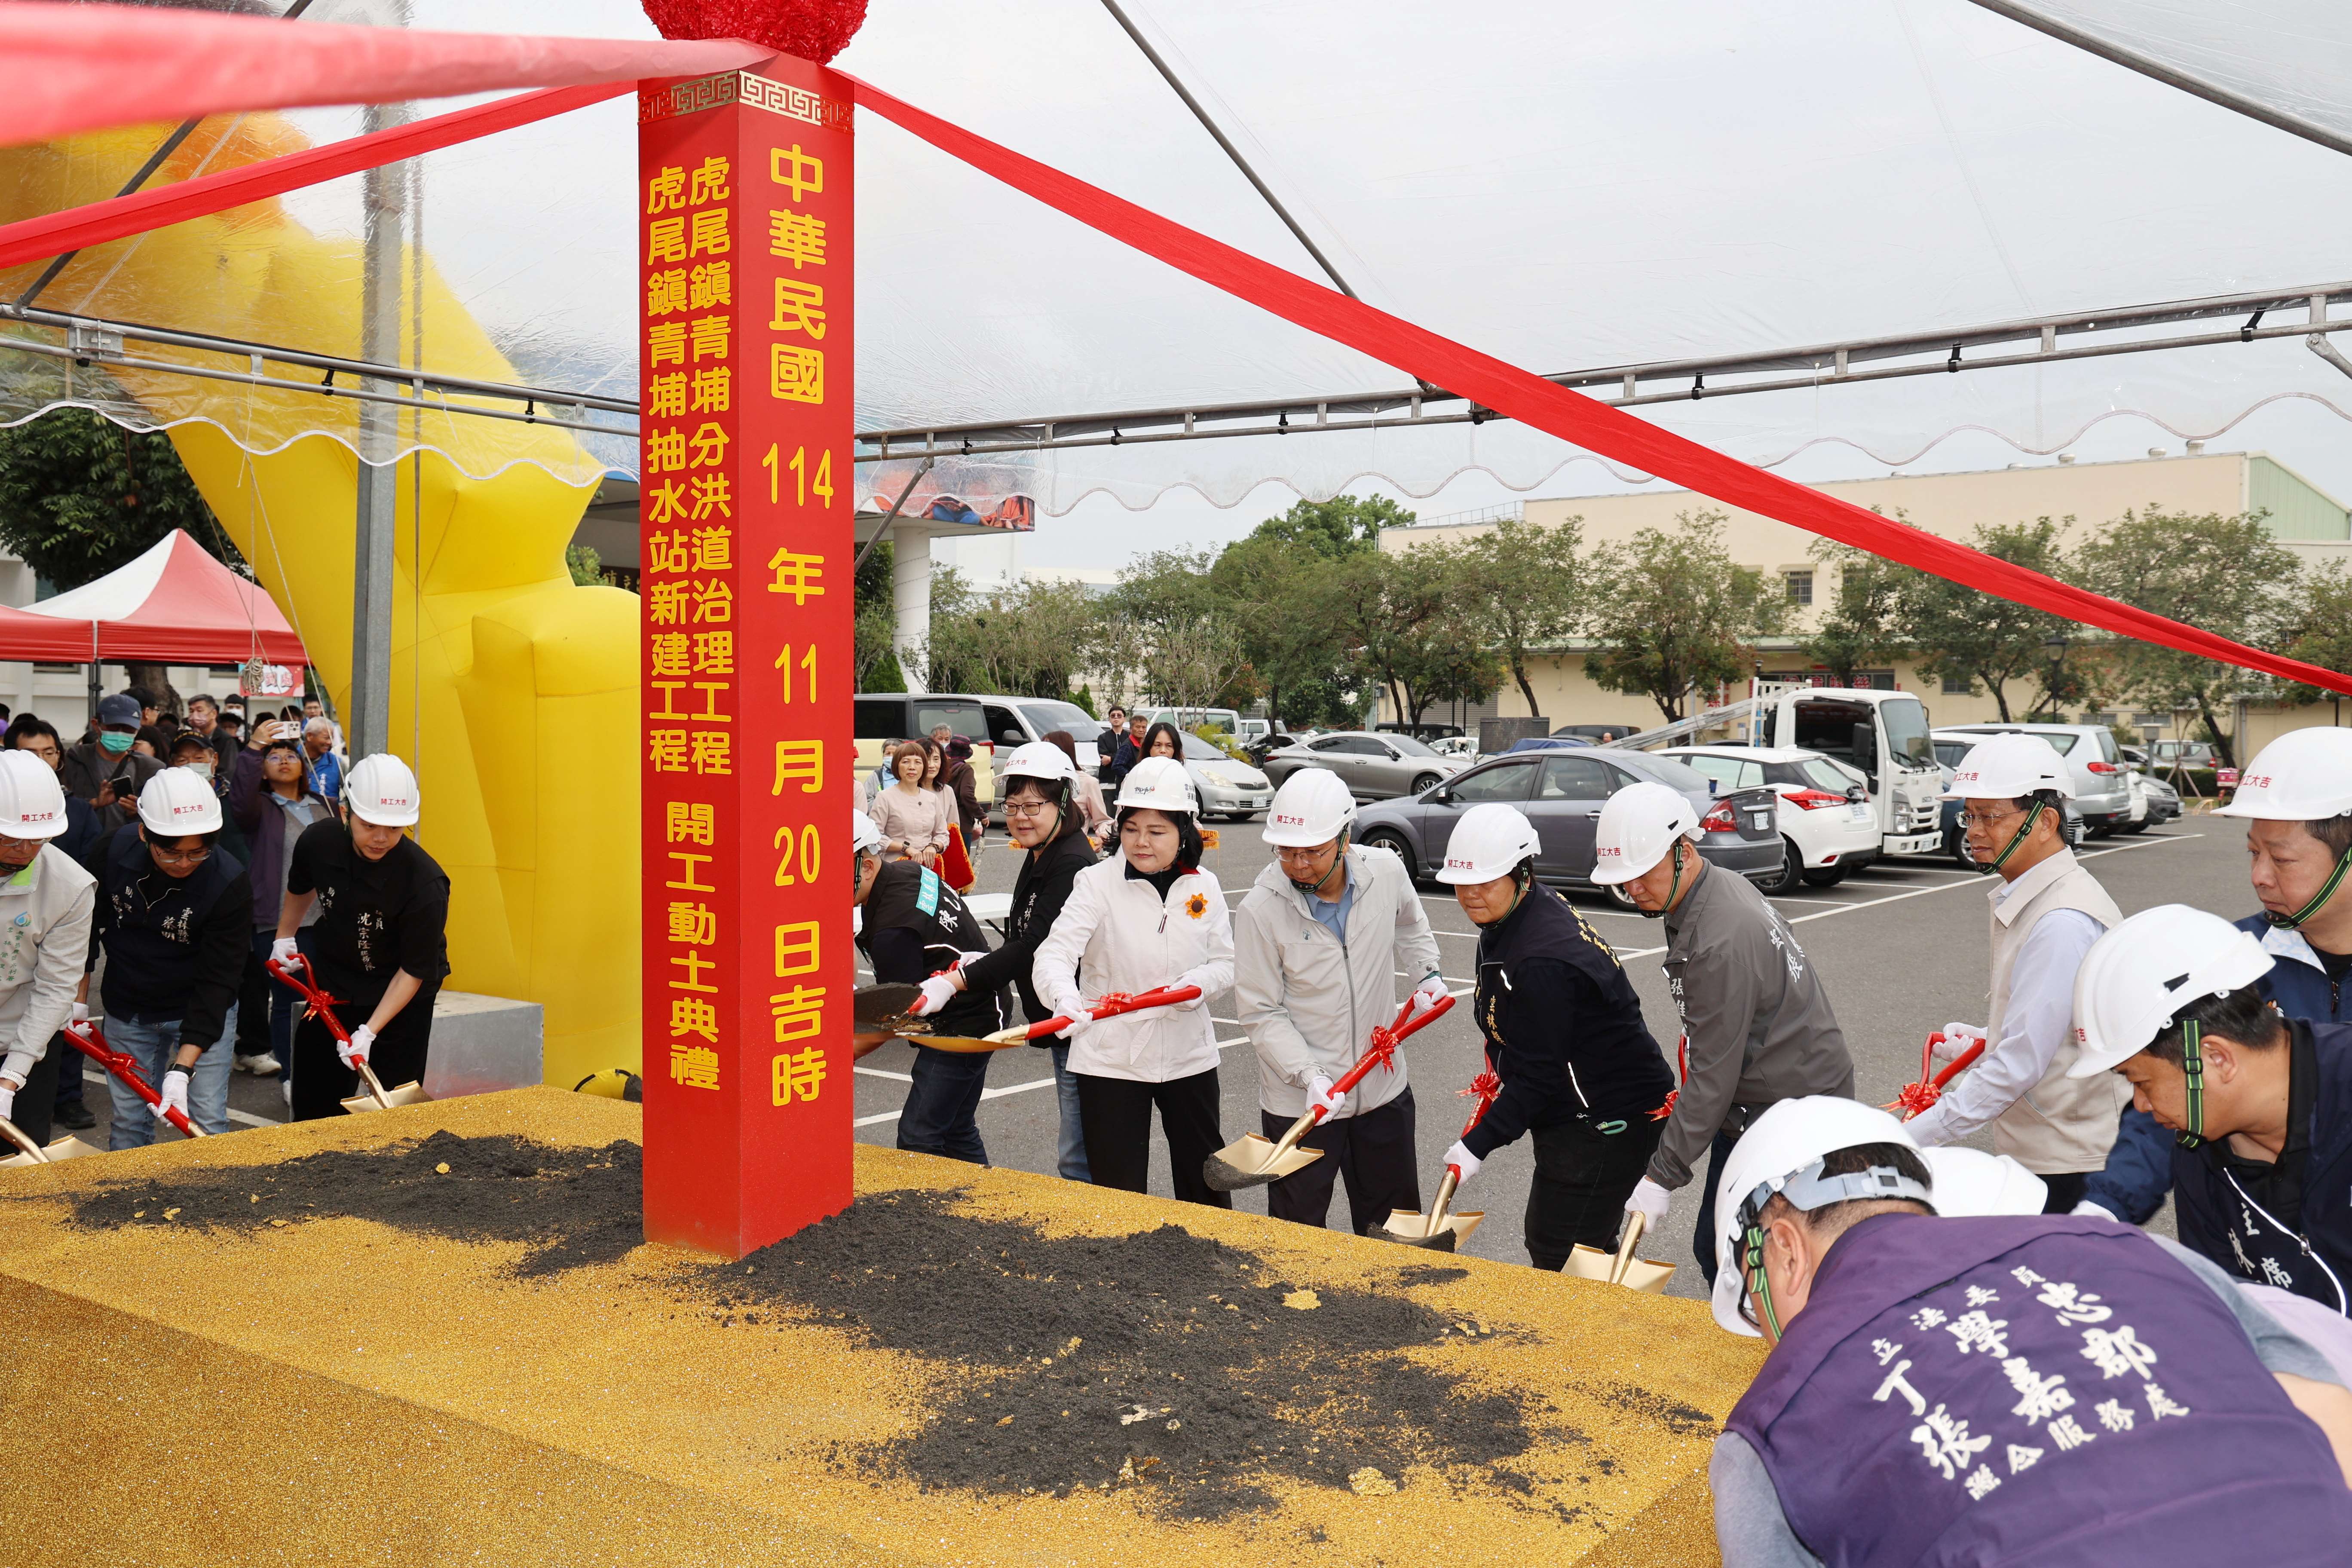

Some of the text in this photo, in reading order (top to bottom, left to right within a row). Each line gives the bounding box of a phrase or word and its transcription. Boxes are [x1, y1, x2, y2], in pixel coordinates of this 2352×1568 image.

[648, 167, 690, 772] 虎尾鎮青埔抽水站新建工程
[690, 157, 733, 775] 虎尾鎮青埔分洪道治理工程
[763, 145, 833, 1106] 中華民國 114 年 11 月 20 日吉時
[22, 812, 53, 822] 開工大吉
[174, 805, 203, 815] 開工大吉
[667, 802, 719, 1090] 開工動土典禮
[1277, 815, 1305, 826] 開工大吉
